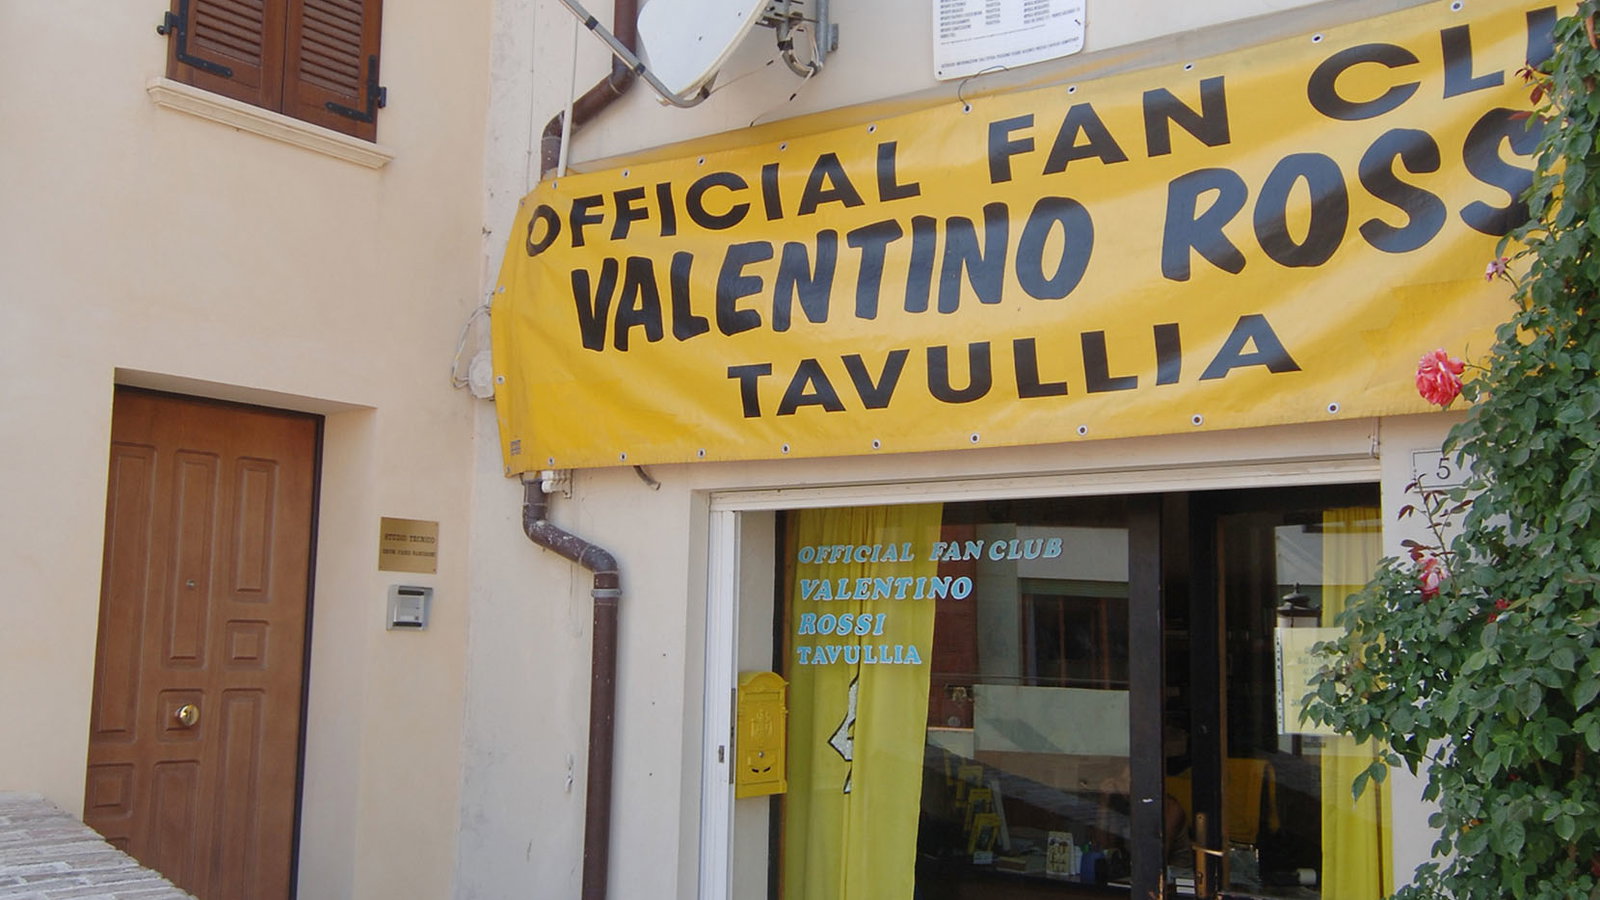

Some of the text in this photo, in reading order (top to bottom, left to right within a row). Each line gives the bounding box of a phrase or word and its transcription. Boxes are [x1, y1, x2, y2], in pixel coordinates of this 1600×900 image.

[526, 141, 921, 257] OFFICIAL
[988, 75, 1231, 184] FAN
[571, 196, 1095, 352] VALENTINO
[728, 314, 1302, 418] TAVULLIA
[1436, 457, 1451, 480] 5
[797, 537, 1064, 565] OFFICIAL FAN CLUB
[799, 576, 974, 601] VALENTINO
[798, 613, 887, 637] ROSSI
[797, 645, 922, 665] TAVULLIA
